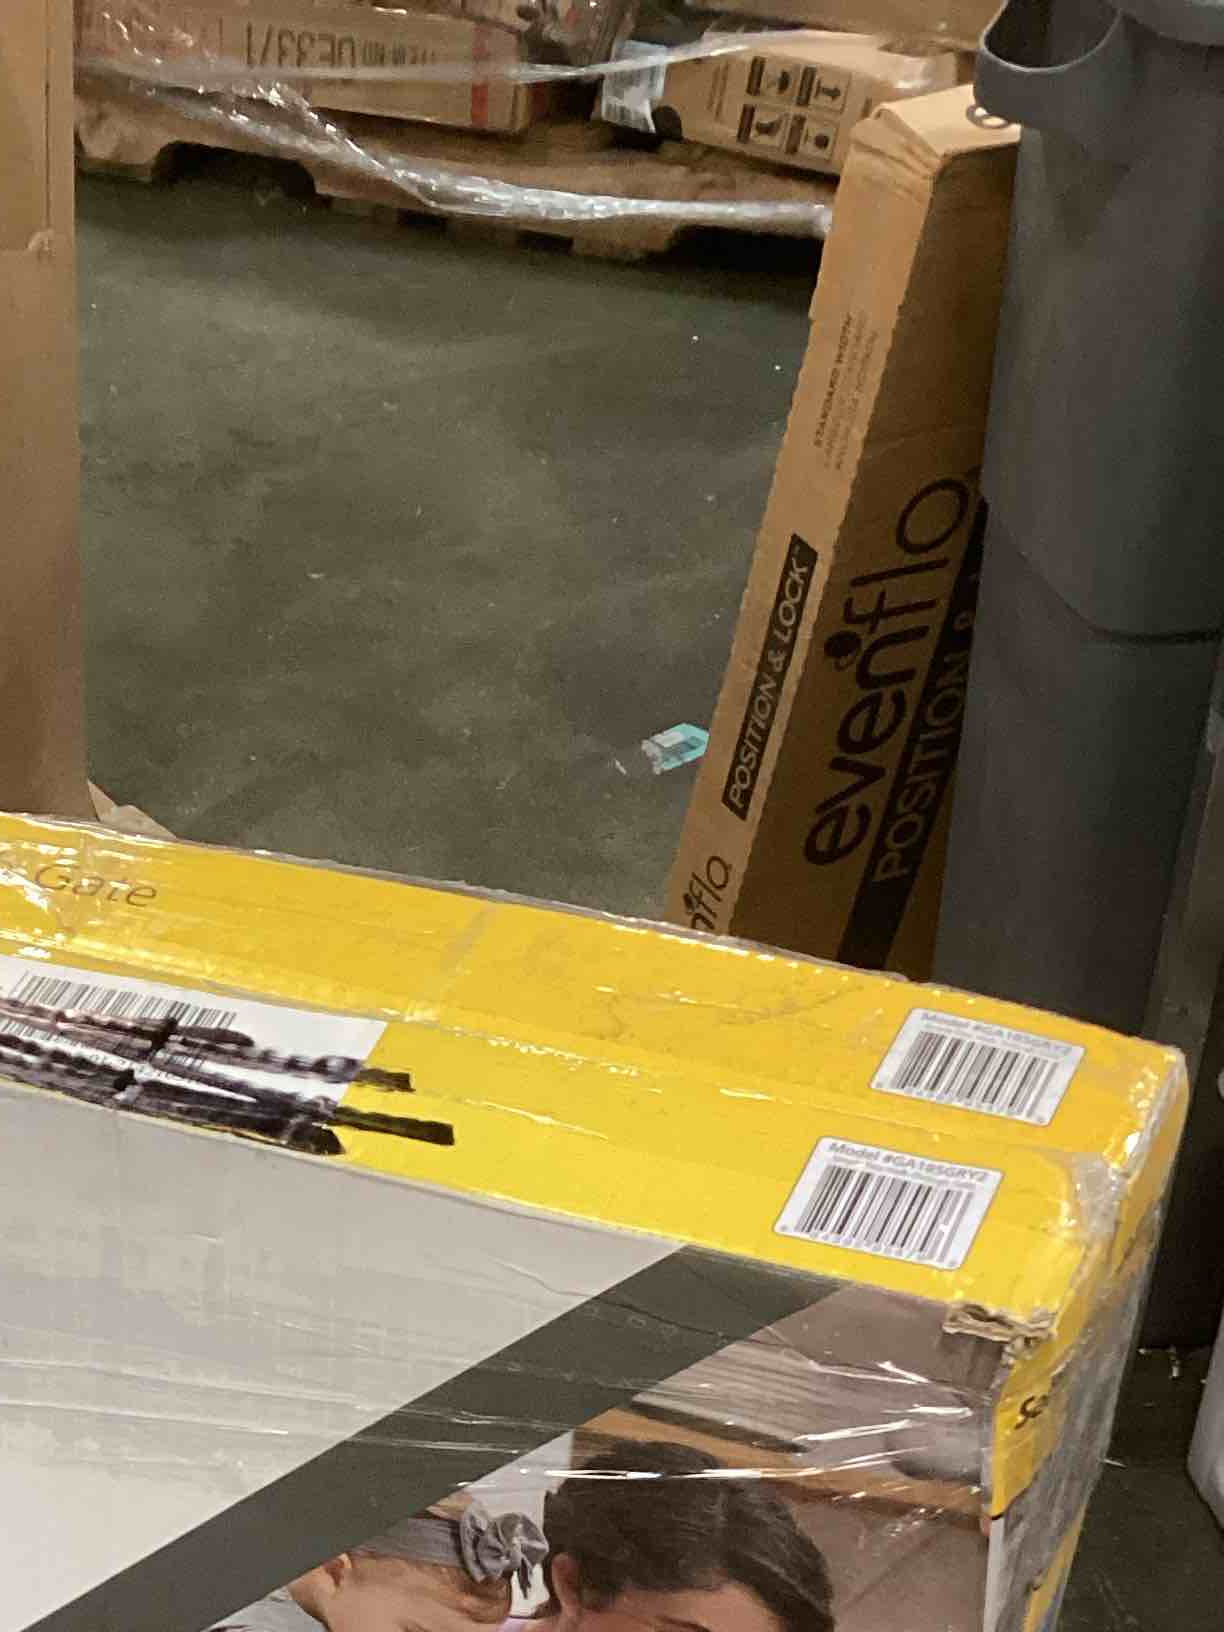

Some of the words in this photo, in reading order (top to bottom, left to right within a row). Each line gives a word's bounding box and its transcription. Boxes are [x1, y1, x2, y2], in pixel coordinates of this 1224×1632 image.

[727, 670, 777, 810] POSITION
[766, 648, 786, 669] &
[803, 476, 973, 866] evenflo
[32, 860, 159, 909] Gate
